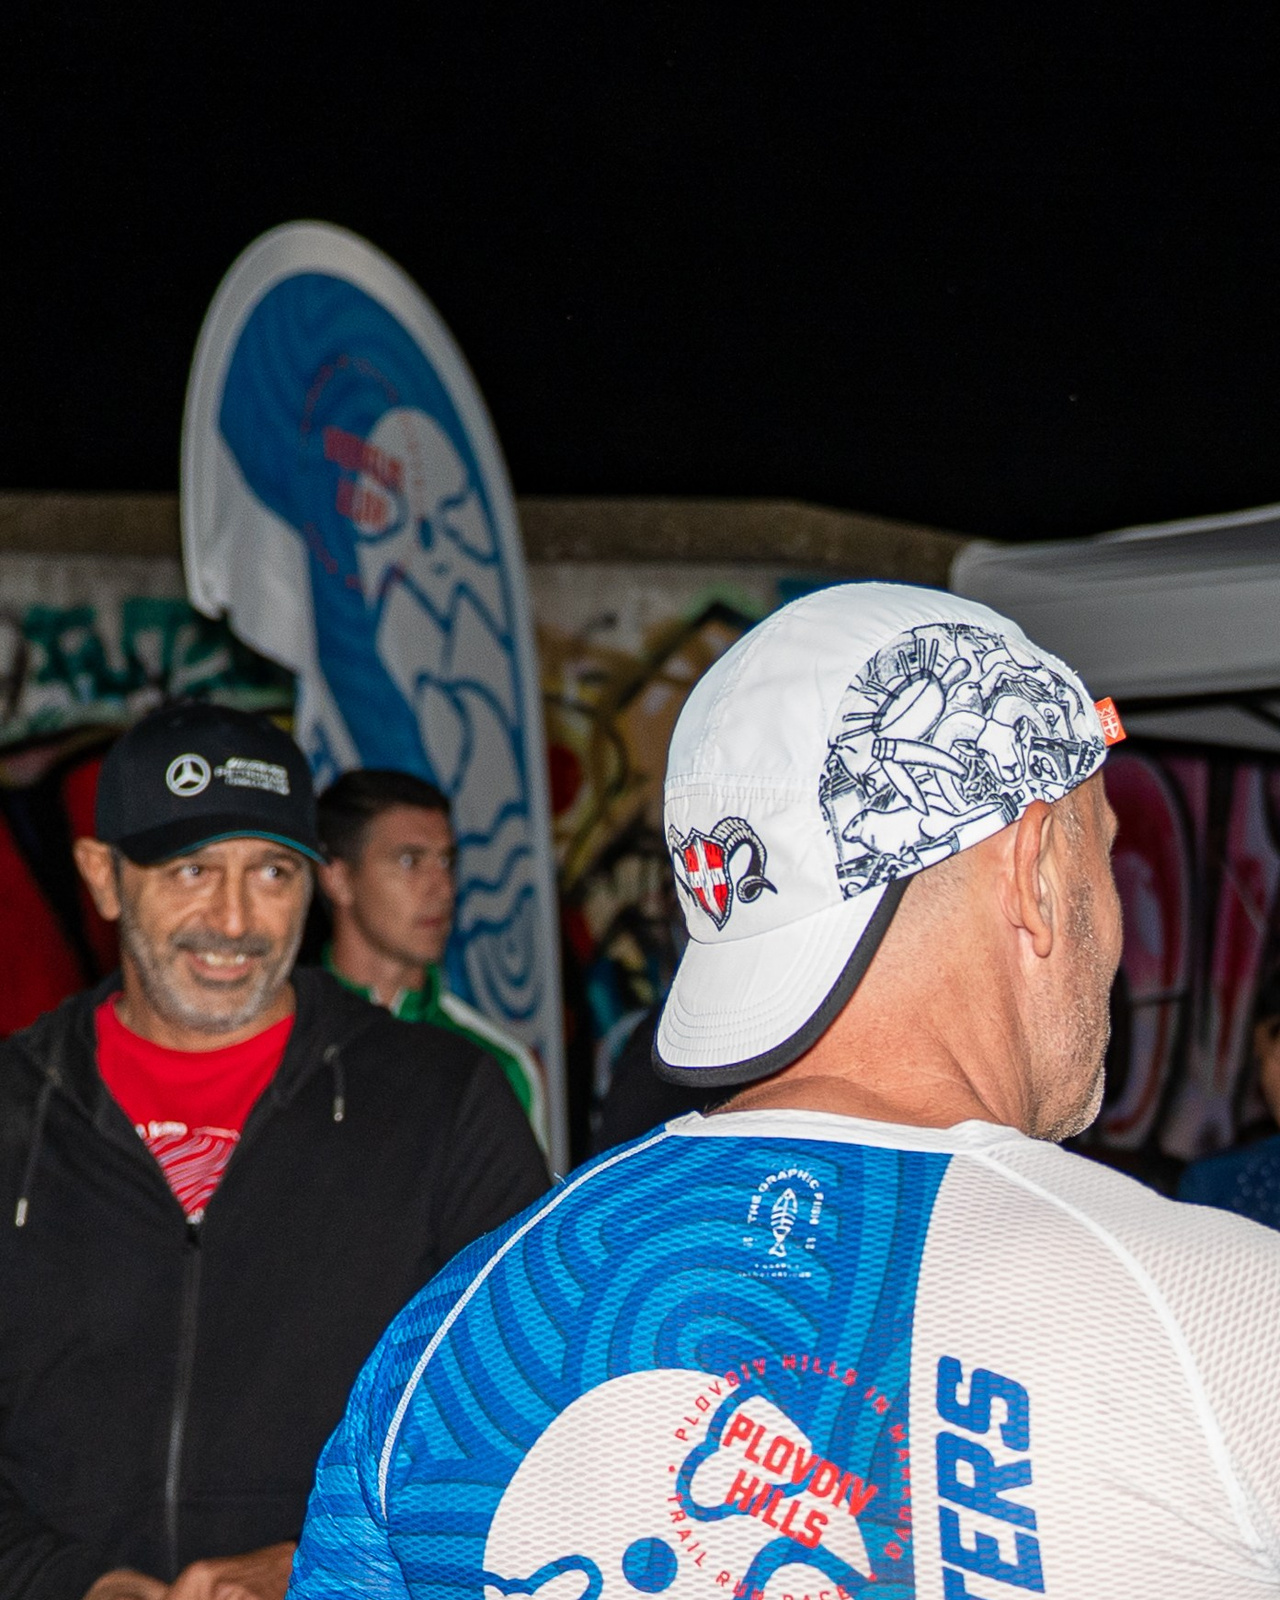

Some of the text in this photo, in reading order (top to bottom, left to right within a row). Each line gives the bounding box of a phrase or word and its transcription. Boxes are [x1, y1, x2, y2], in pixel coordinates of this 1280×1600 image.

[747, 1195, 762, 1224] THE
[758, 1168, 820, 1193] GRAPHIC
[675, 1358, 767, 1442] PLOVDIV
[782, 1354, 859, 1387] HILLS
[864, 1385, 891, 1415] IN
[722, 1413, 878, 1517] PLOVDIV
[667, 1494, 707, 1567] TRAIL
[725, 1469, 829, 1549] HILLS
